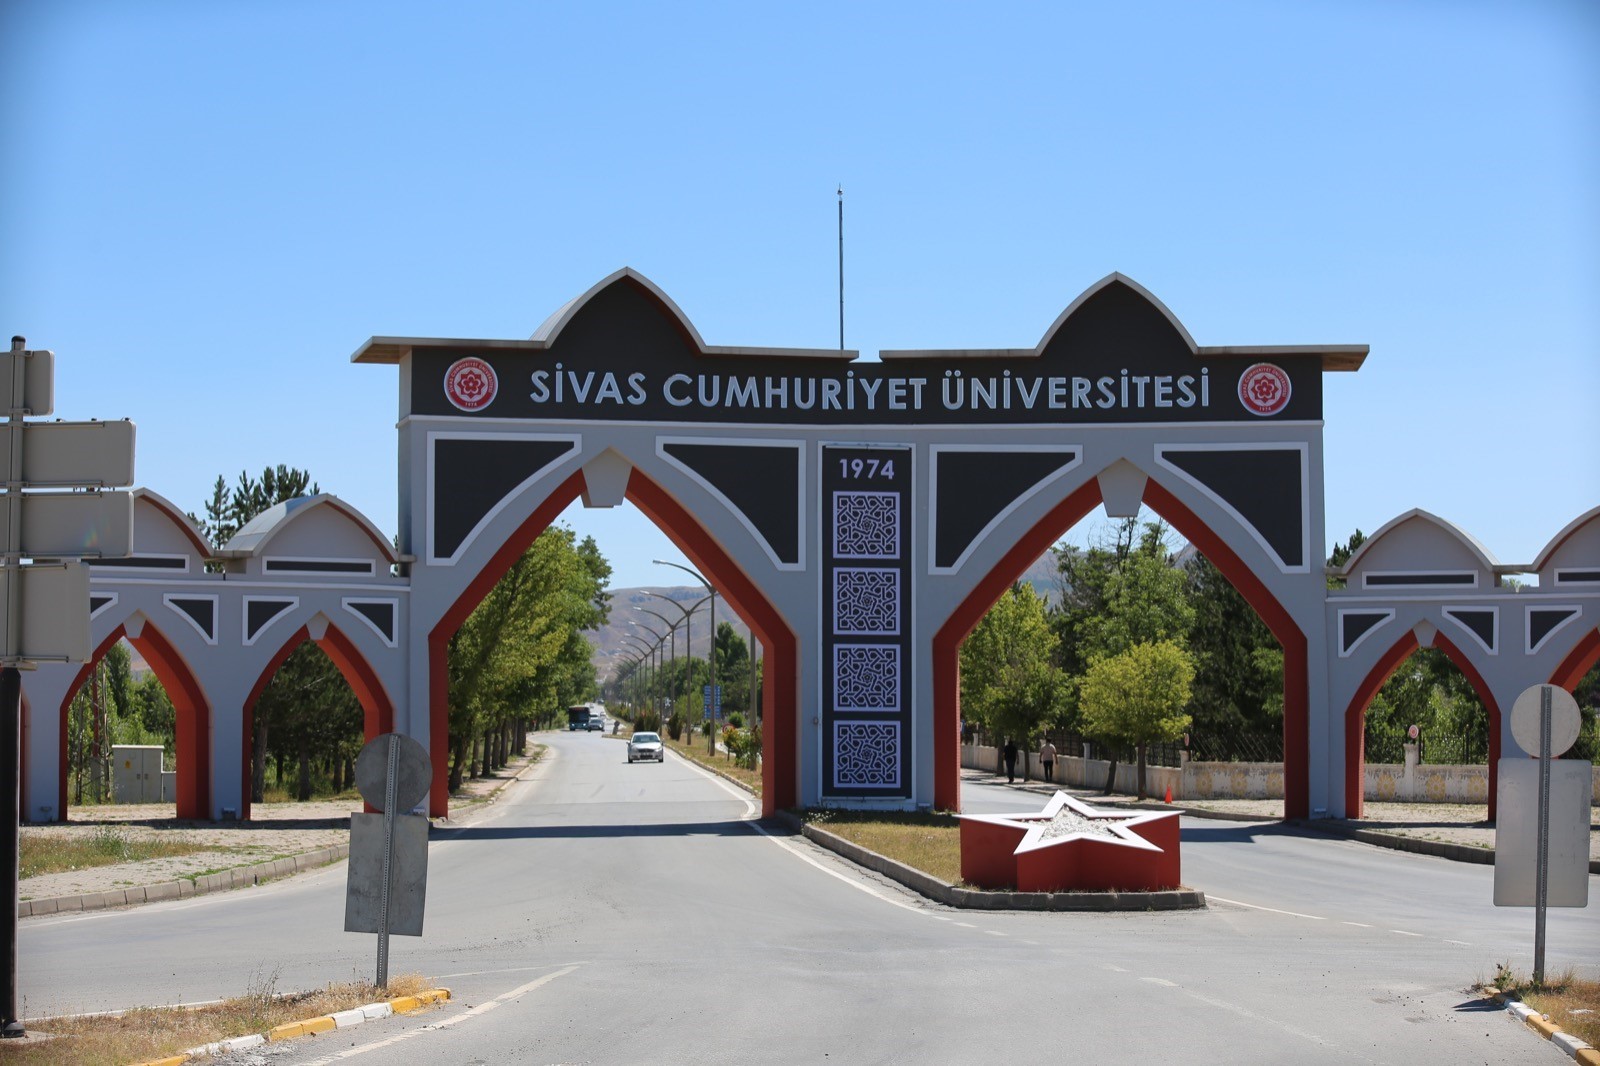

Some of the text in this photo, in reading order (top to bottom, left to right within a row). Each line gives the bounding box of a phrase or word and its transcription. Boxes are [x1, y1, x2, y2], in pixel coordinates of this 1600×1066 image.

[529, 362, 1210, 411] SİVAS CUMHURİYET ÜNİVERSİTESİ
[839, 458, 895, 480] 1974
